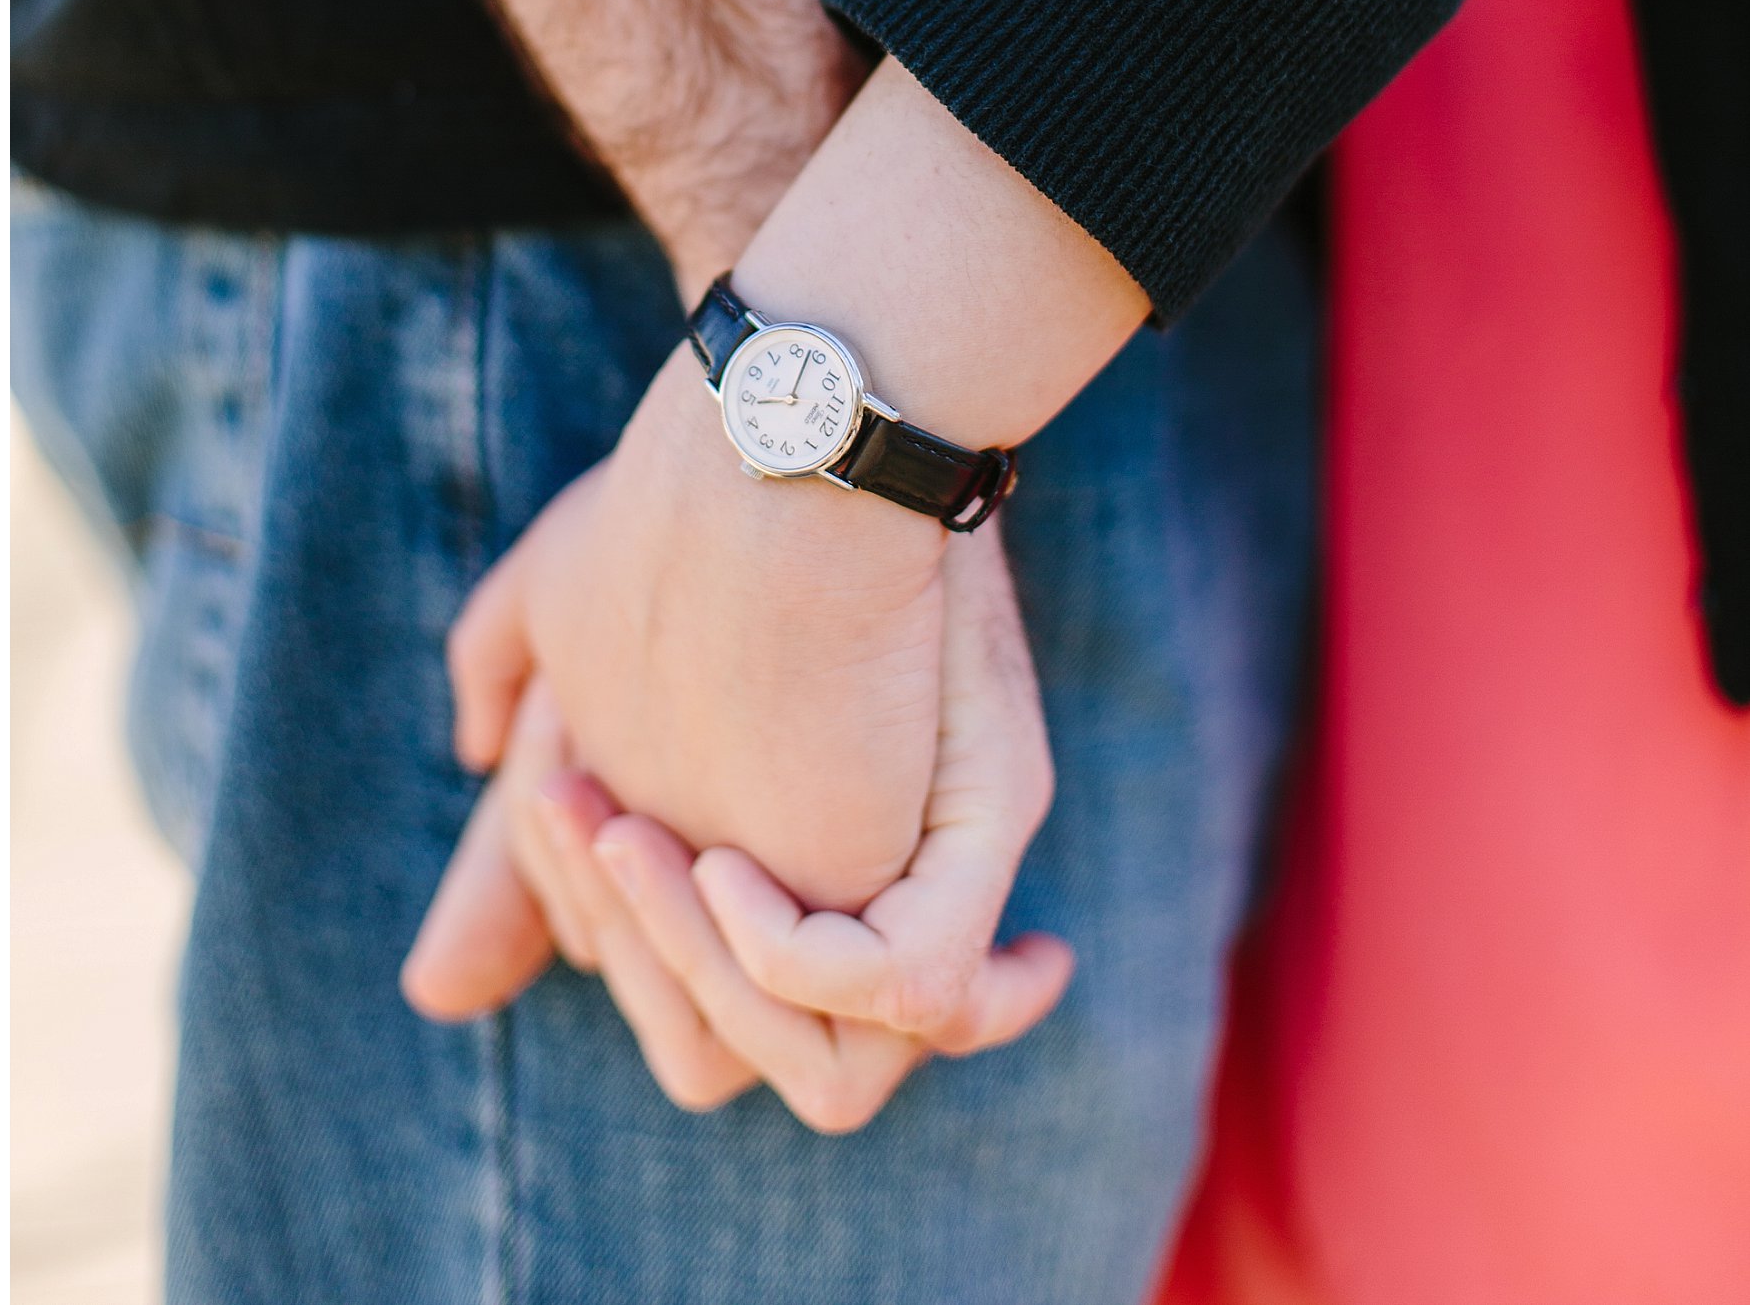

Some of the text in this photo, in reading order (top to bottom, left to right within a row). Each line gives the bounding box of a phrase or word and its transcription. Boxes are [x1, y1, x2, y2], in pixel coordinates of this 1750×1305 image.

[767, 351, 781, 366] 7
[789, 343, 804, 359] 8
[812, 349, 827, 365] 9
[748, 365, 763, 381] 6
[822, 369, 842, 392] 10
[741, 390, 757, 406] 5
[825, 393, 846, 414] 11
[746, 416, 759, 430] 4
[819, 416, 840, 437] 12
[759, 433, 774, 449] 3
[780, 440, 795, 456] 2
[804, 438, 819, 450] 1
